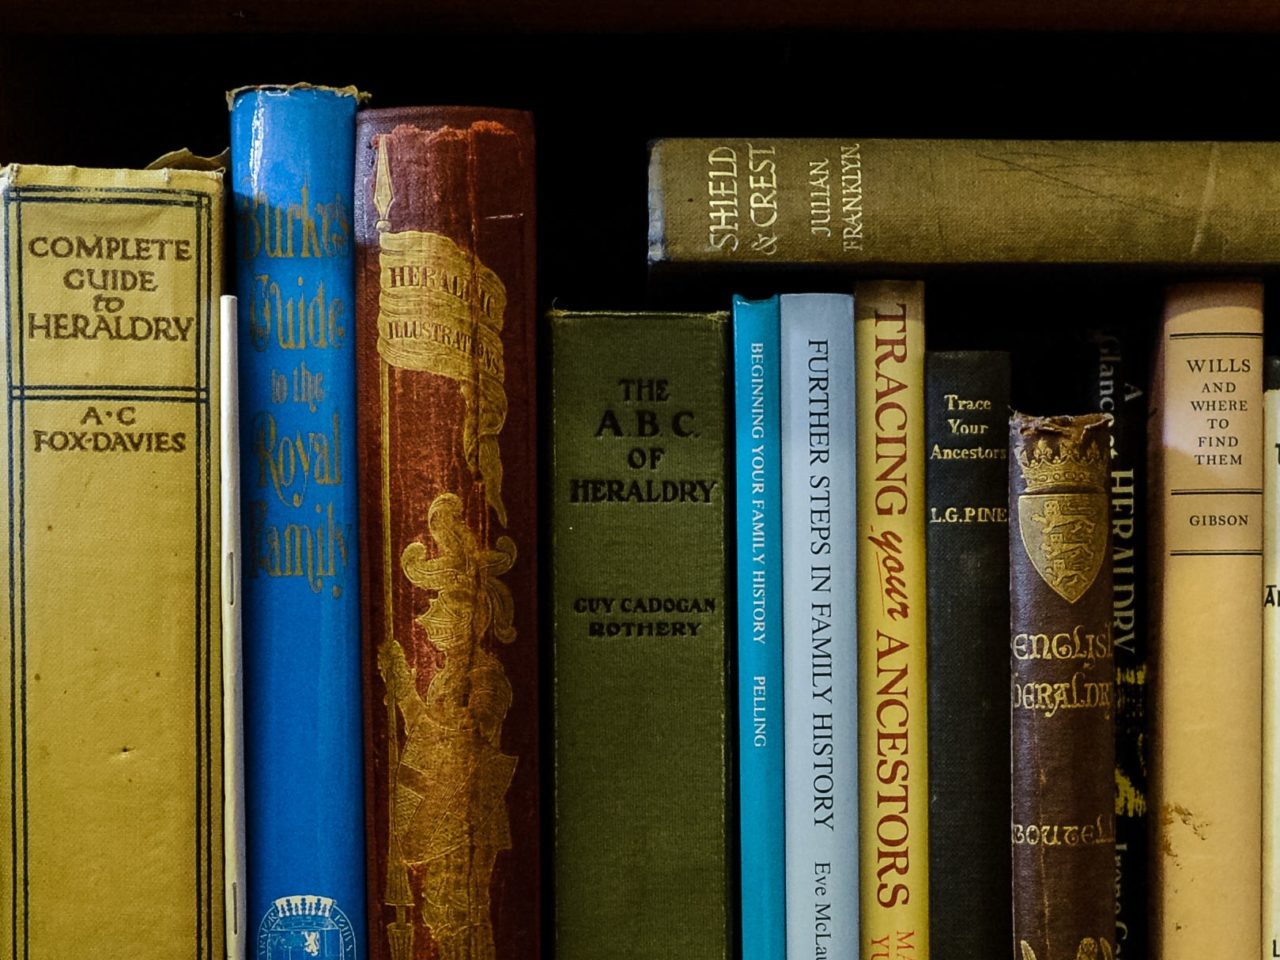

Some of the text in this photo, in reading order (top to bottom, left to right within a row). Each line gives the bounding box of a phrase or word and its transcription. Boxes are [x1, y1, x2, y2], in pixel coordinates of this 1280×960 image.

[708, 147, 739, 251] SHIELD
[809, 158, 831, 237] JULIAN
[841, 143, 863, 252] FRANKLYN
[28, 235, 192, 262] COMPLETE
[63, 268, 158, 292] GUIDE
[27, 315, 194, 342] HERALDRY
[1186, 358, 1251, 373] WILLS
[618, 379, 670, 402] THE
[1201, 382, 1236, 393] AND
[874, 303, 908, 516] TRACING
[944, 395, 991, 412] Trace
[1191, 401, 1248, 412] WHERE
[947, 419, 988, 436] Your
[1207, 418, 1229, 429] TO
[34, 430, 186, 453] FOX-DAVIES
[1198, 437, 1239, 448] FIND
[627, 448, 666, 471] OF
[1194, 454, 1243, 466] THEM
[569, 479, 718, 503] HERALDRY
[751, 342, 766, 645] BEGINNING YOUR FAMILY HISTORY
[1189, 515, 1249, 527] GIBSON
[808, 339, 835, 832] FURTHER STEPS IN FAMILY HISTORY
[573, 598, 716, 614] GUY CADOGAN
[588, 621, 702, 638] ROTHERY
[753, 675, 767, 748] PELLING
[875, 629, 910, 909] ANCESTORS
[814, 861, 831, 896] Eve
